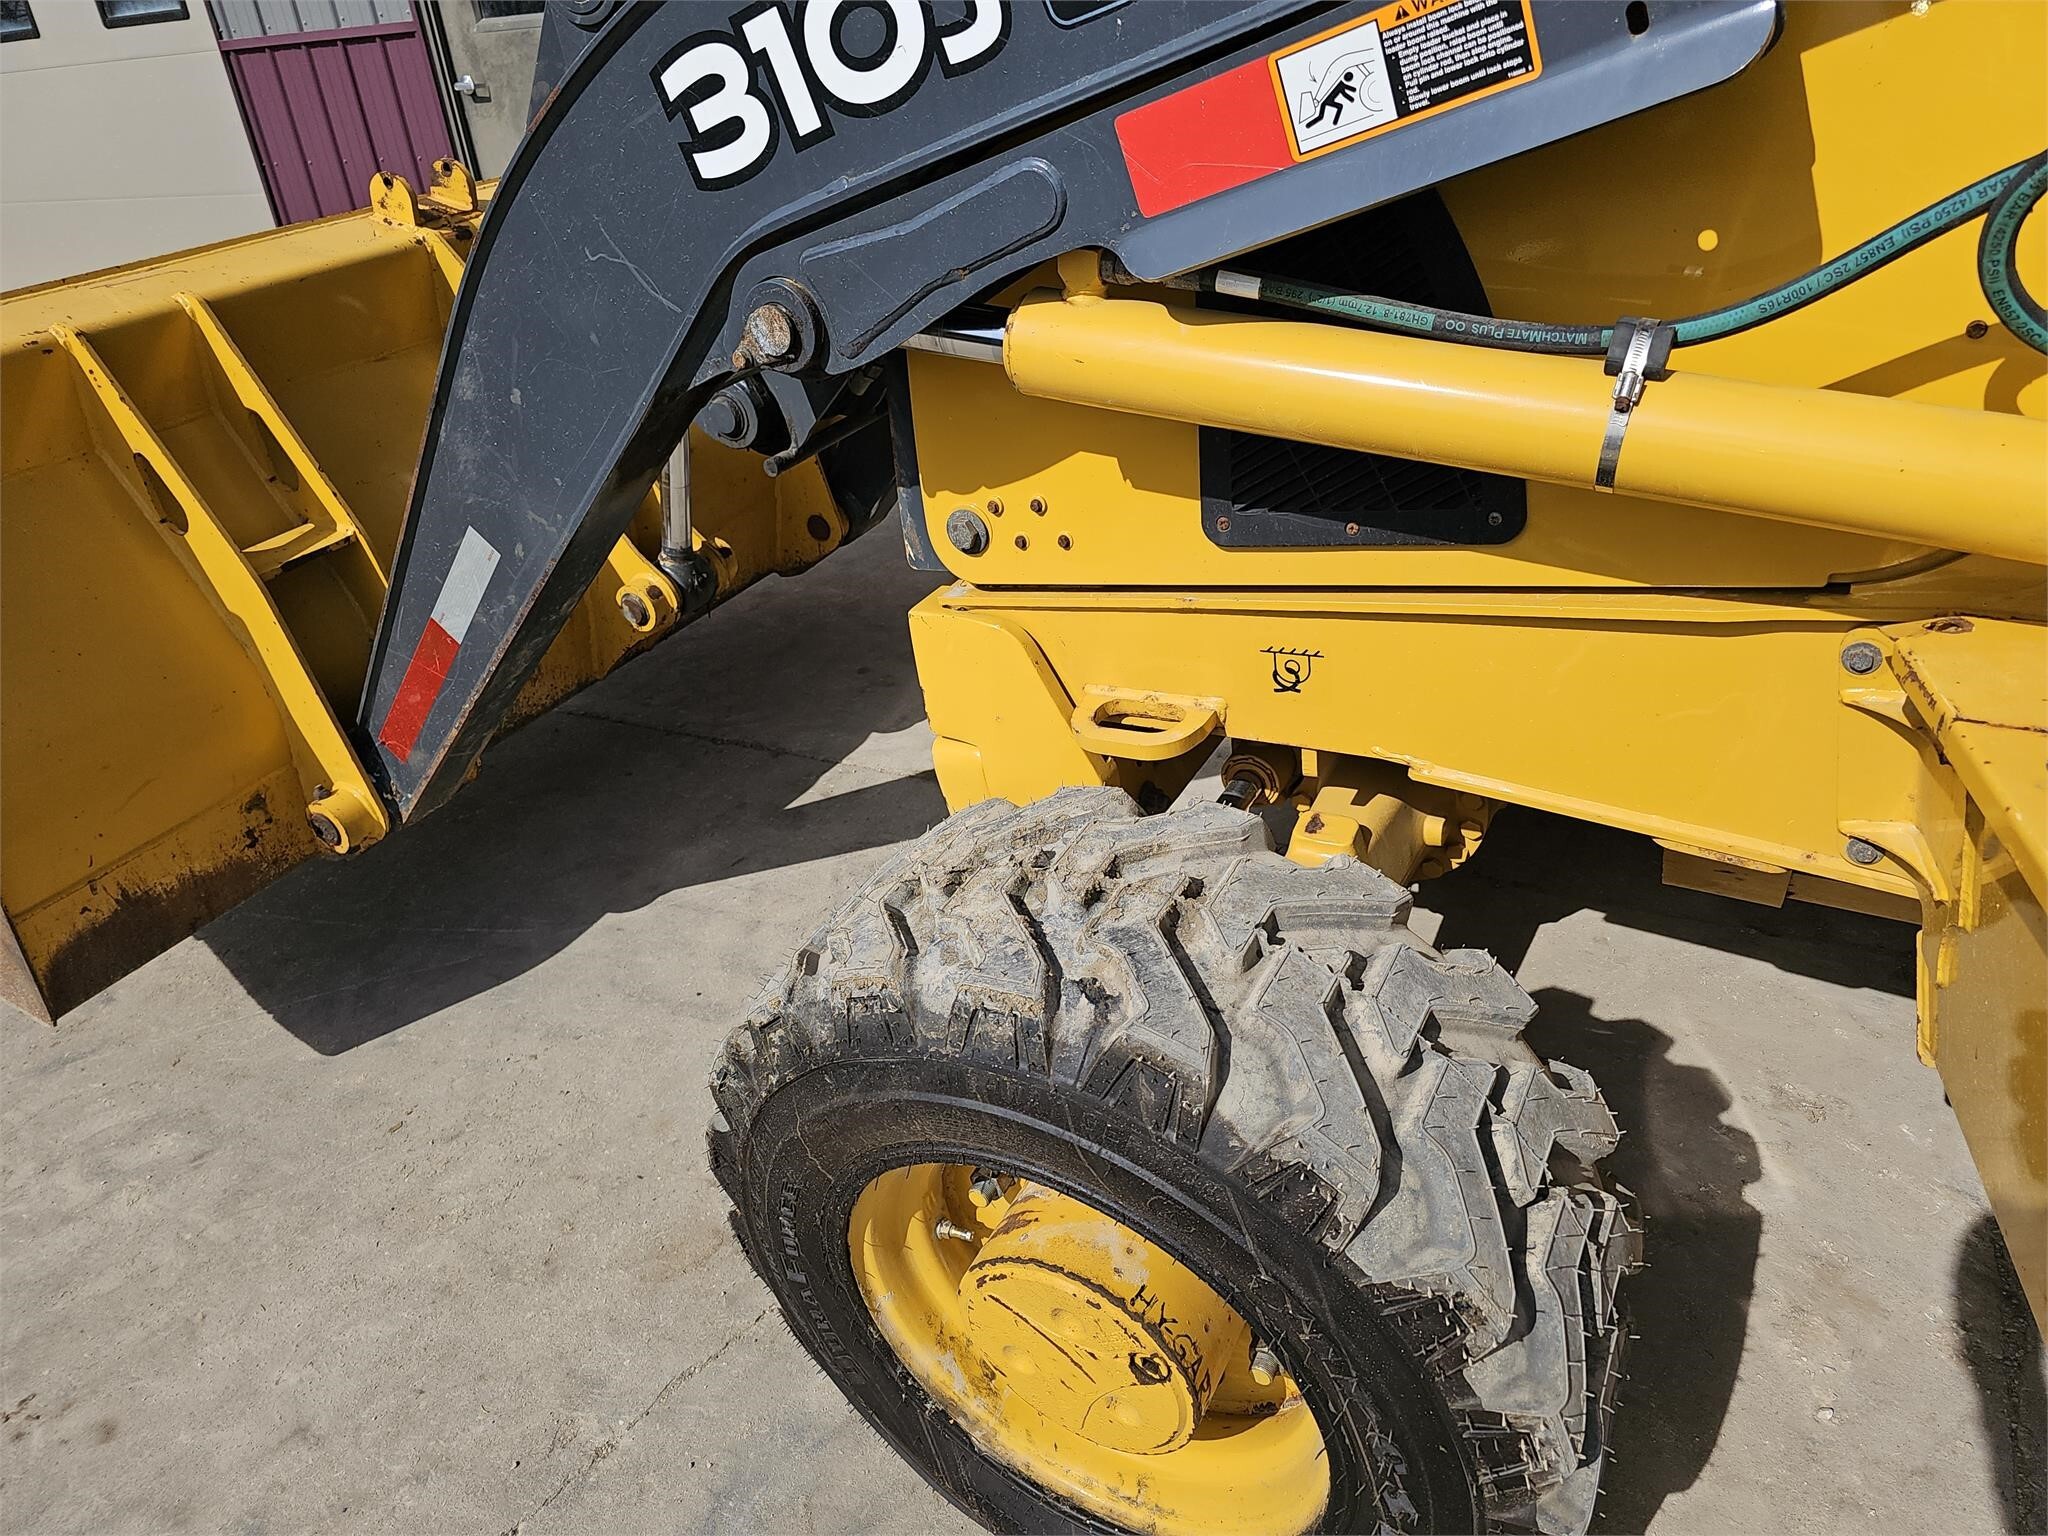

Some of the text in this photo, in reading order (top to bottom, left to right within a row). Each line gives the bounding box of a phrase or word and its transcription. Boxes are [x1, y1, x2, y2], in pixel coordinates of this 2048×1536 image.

[1382, 25, 1406, 40] Always
[1406, 16, 1427, 30] install
[1427, 9, 1448, 21] boom
[1447, 2, 1463, 14] lock
[1383, 39, 1393, 47] on
[1402, 25, 1426, 40] around
[1426, 20, 1440, 30] this
[1440, 9, 1470, 25] machine
[1469, 2, 1486, 13] with
[1398, 10, 1508, 58] Empty loader bucket and place in
[1385, 24, 1450, 55] loader boom raised.
[1400, 54, 1419, 66] dump
[1449, 35, 1466, 47] raise
[1466, 28, 1488, 40] boom
[1487, 20, 1504, 32] until
[1400, 20, 1525, 74] boom lock channel can be positioned
[1402, 72, 1412, 81] on
[1412, 62, 1439, 78] cylinder
[1454, 51, 1470, 62] then
[1470, 44, 1487, 56] stop
[1404, 38, 1525, 89] Pull pin and lower lock onto cylinder
[1407, 90, 1430, 103] Slowly
[1430, 83, 1450, 95] lower
[1450, 75, 1470, 88] boom
[1470, 68, 1487, 81] until
[1486, 61, 1503, 75] lock
[1502, 55, 1523, 69] stops
[1934, 191, 1974, 223] (4250
[2005, 193, 2031, 221] BAR
[1854, 235, 1897, 269] EN857
[1826, 262, 1850, 283] 2SC
[1338, 299, 1379, 316] 12.7mm
[1759, 284, 1813, 315] 100R16S
[1384, 311, 1429, 327] GH781-8
[1471, 323, 1504, 340] PLUS
